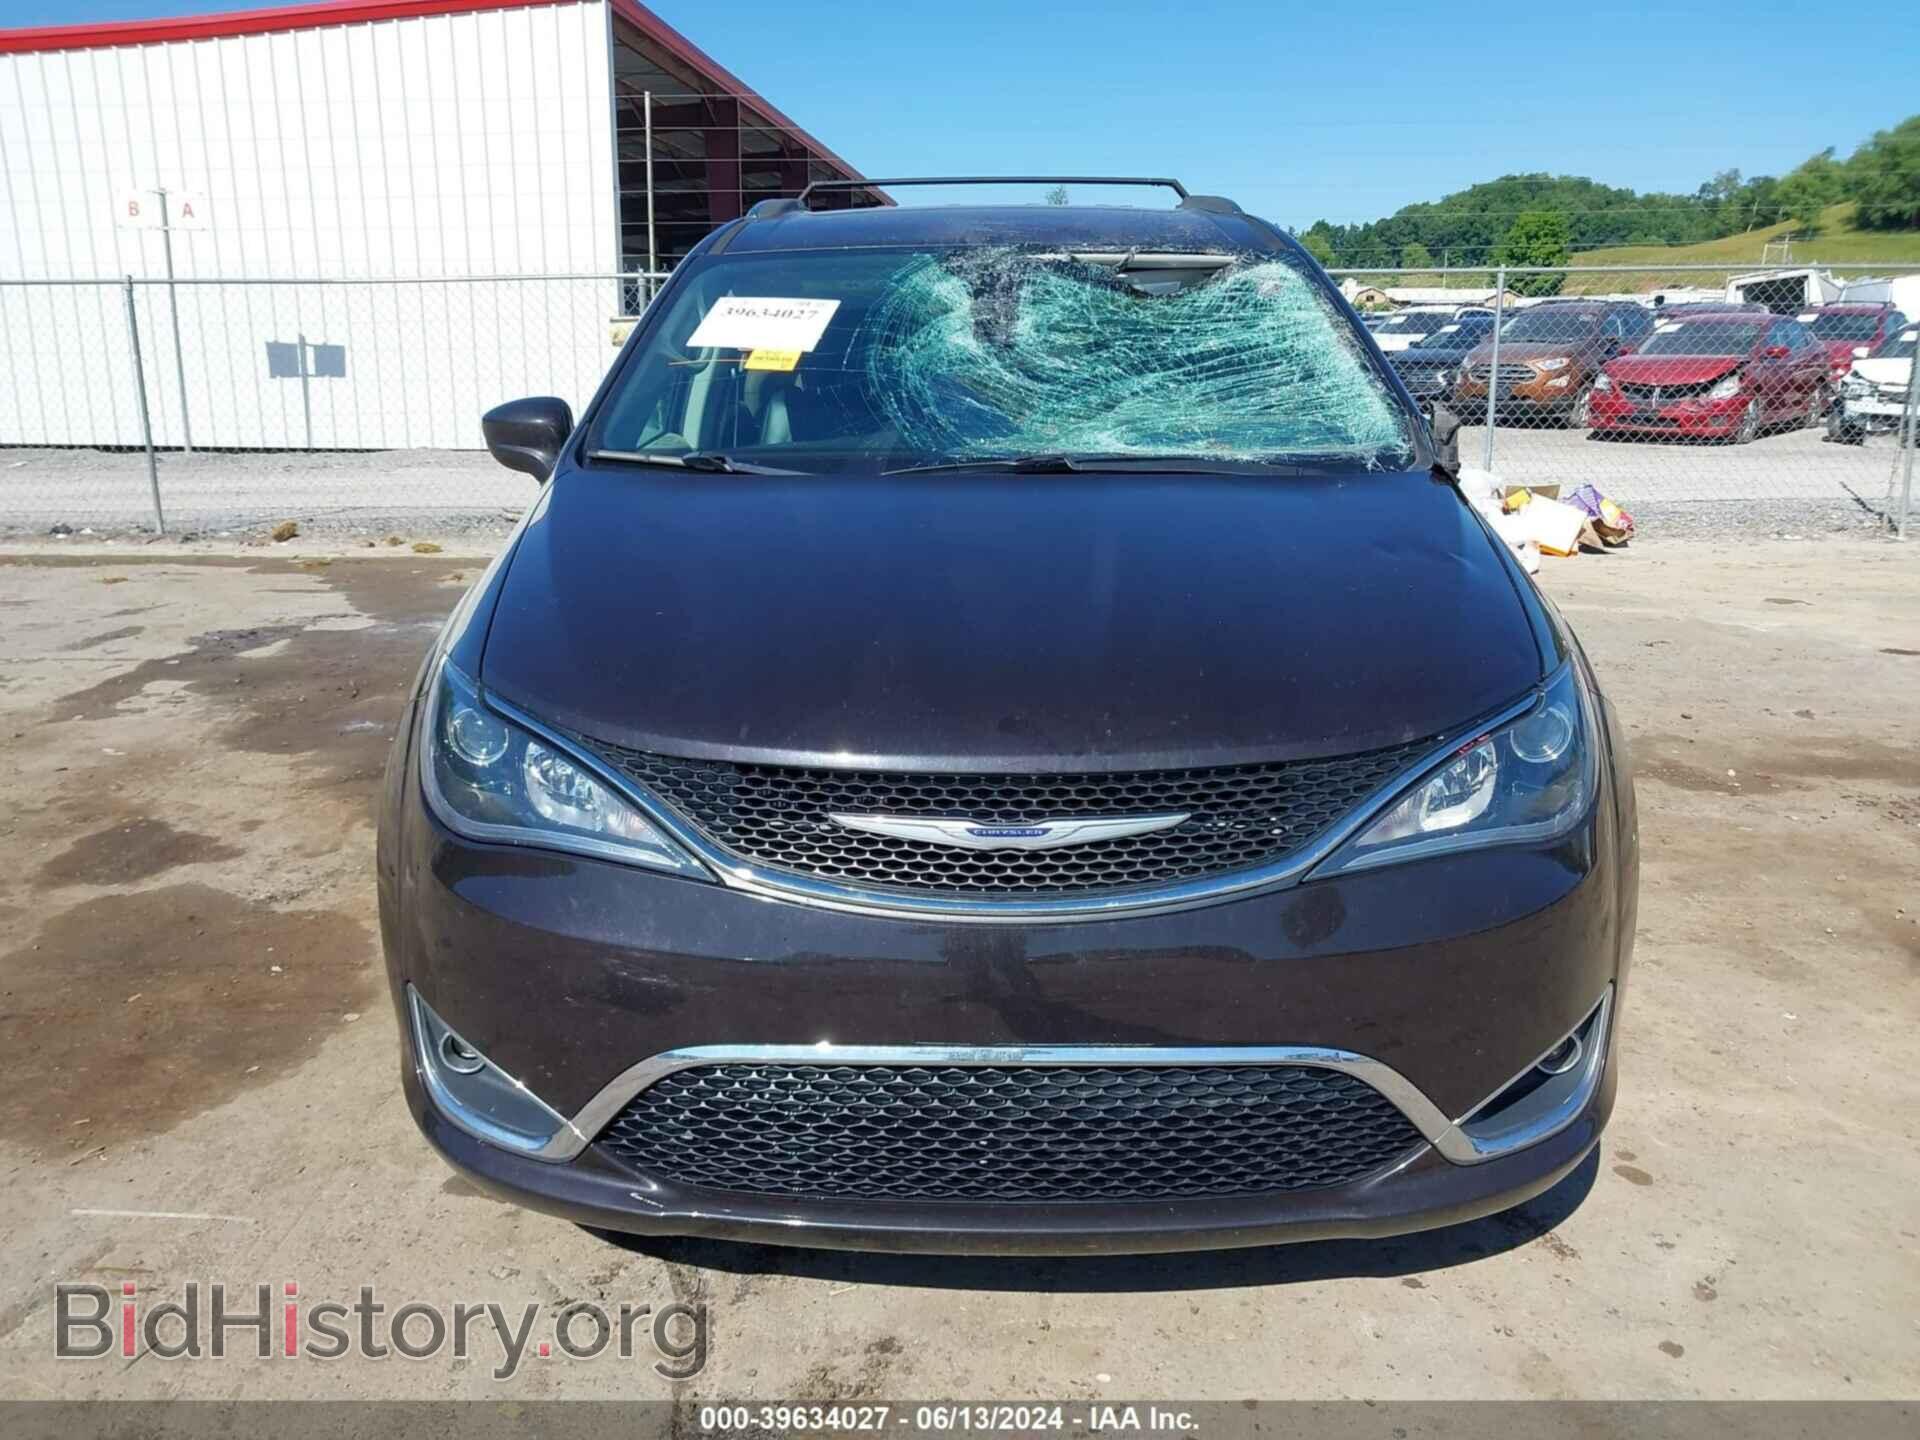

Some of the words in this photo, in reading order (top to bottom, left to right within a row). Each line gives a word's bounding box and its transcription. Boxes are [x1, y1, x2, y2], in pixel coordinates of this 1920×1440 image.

[128, 201, 140, 217] B
[182, 203, 195, 218] A
[720, 306, 820, 321] 39634027
[972, 828, 1044, 837] CHRYSLER
